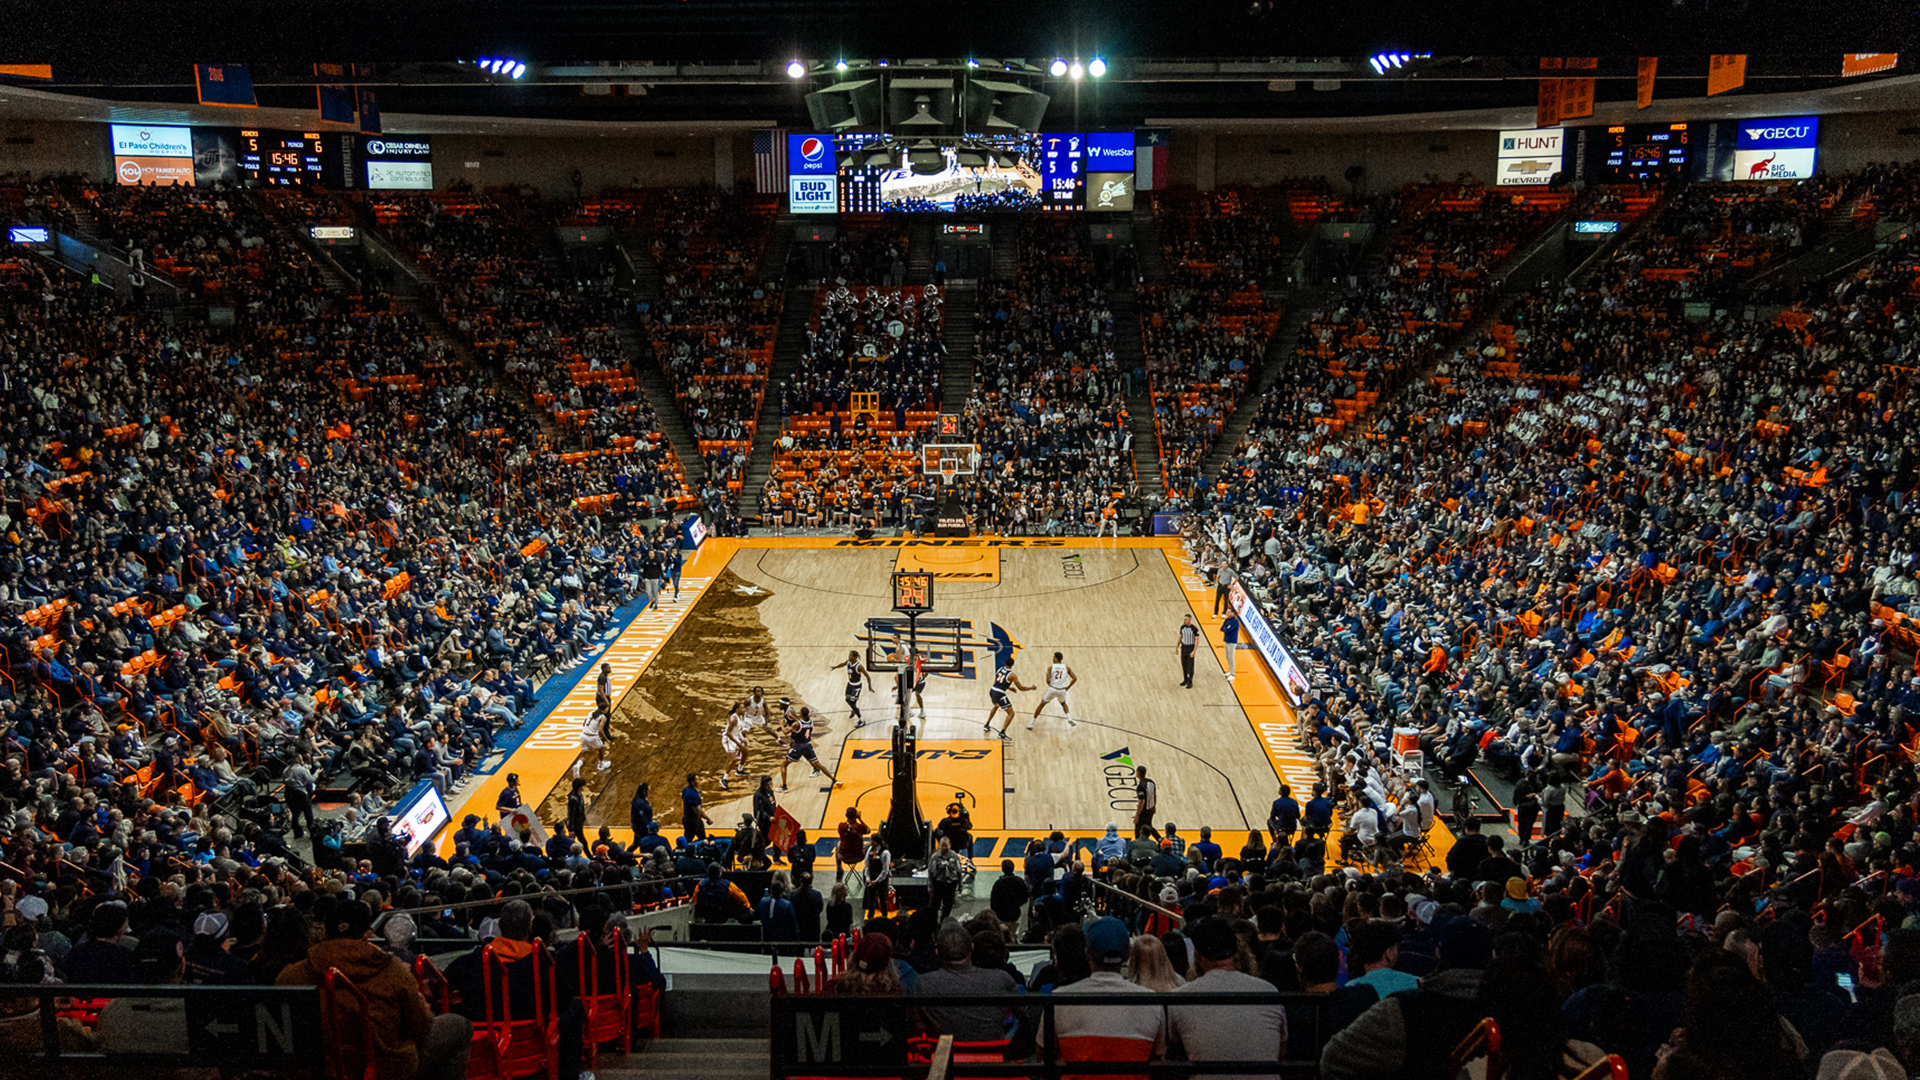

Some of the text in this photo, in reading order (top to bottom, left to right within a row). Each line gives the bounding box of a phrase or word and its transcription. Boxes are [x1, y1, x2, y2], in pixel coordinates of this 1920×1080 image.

[1680, 132, 1688, 144] 6
[1764, 127, 1809, 139] GECU
[149, 142, 187, 150] Children's
[249, 139, 258, 151] 5
[1518, 137, 1559, 149] HUNT
[1616, 135, 1622, 146] 5
[314, 141, 322, 153] 6
[1103, 148, 1134, 156] WestStar
[1635, 146, 1660, 158] 15:46
[272, 152, 298, 165] 15:46
[1049, 161, 1056, 173] 5
[1071, 161, 1078, 173] 6
[800, 182, 826, 191] BUD
[1052, 178, 1075, 190] 15:46
[795, 192, 831, 200] LIGHT
[942, 422, 956, 434] 24
[901, 587, 924, 607] 24
[524, 576, 712, 750] THE UNIVERSITY OF TEXAS AT EL PASO
[1055, 670, 1063, 680] 21
[1258, 722, 1324, 803] GLORY ROAD
[1103, 765, 1138, 811] GECU
[254, 1002, 294, 1053] N
[796, 1012, 841, 1062] M
